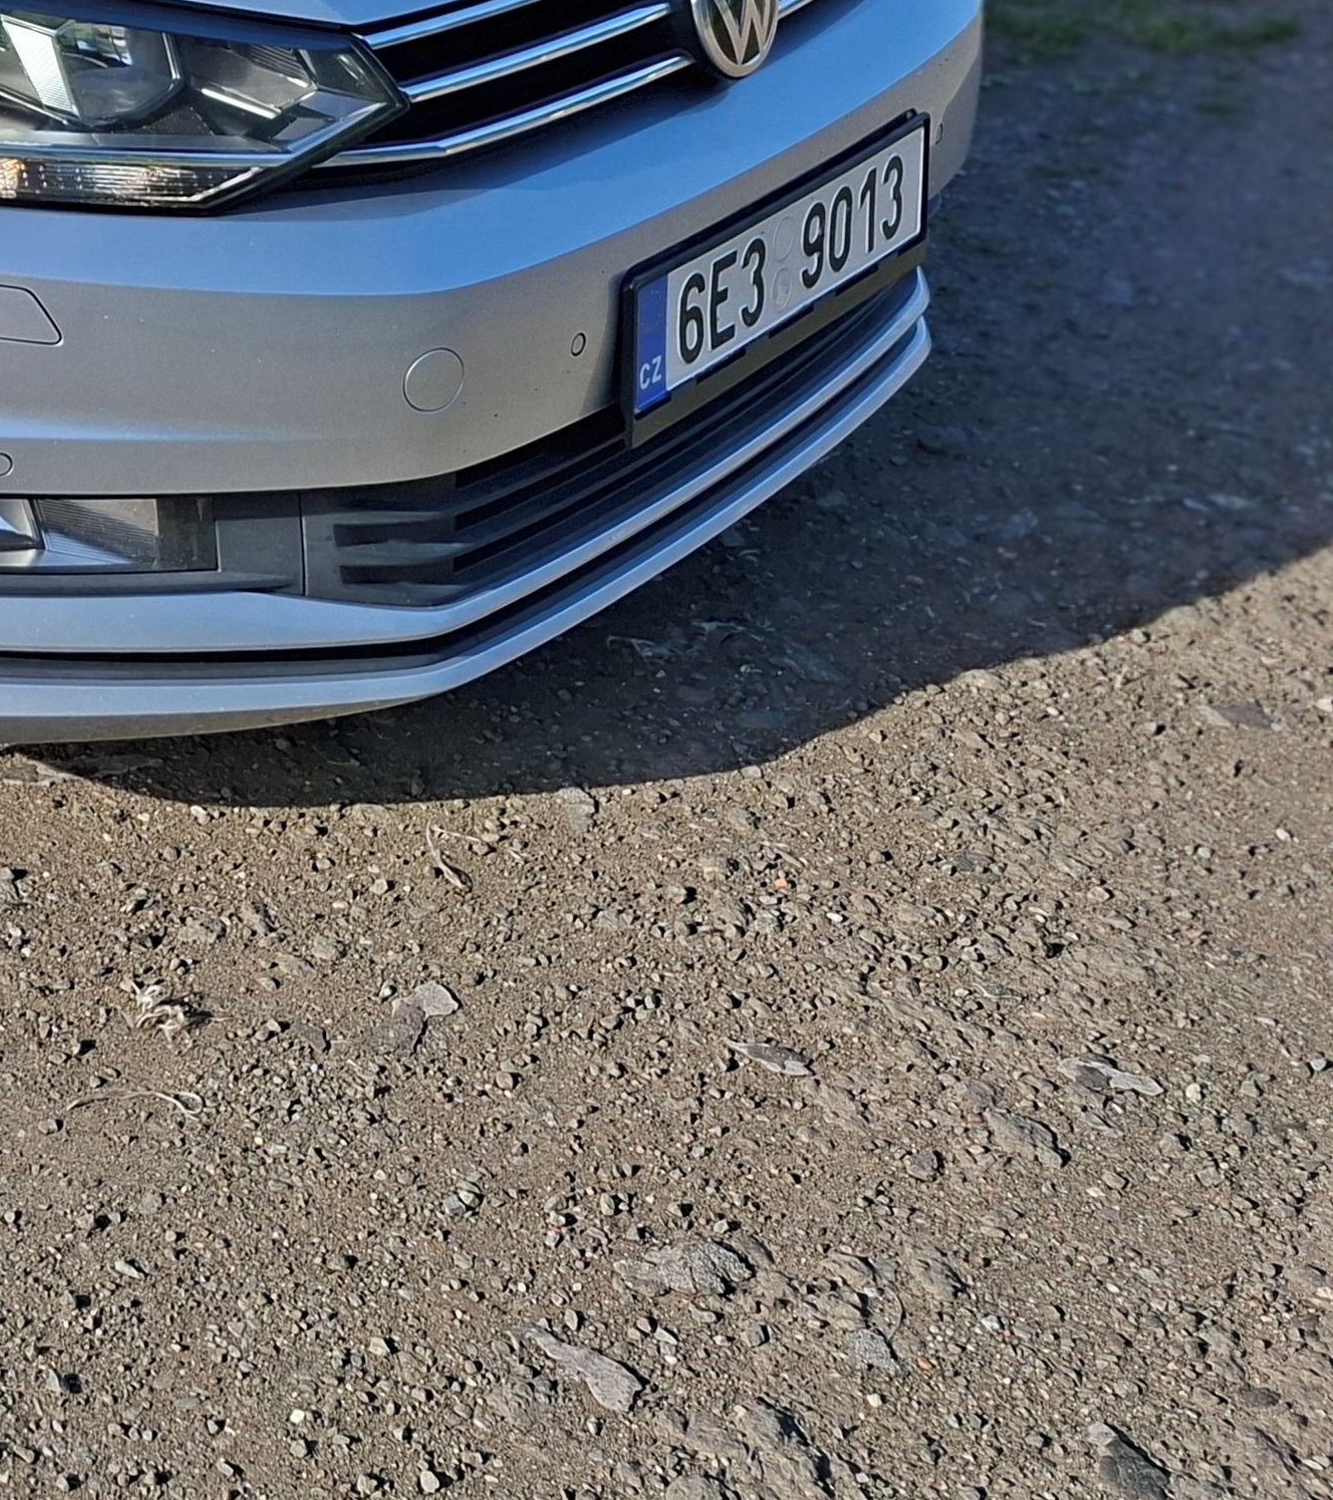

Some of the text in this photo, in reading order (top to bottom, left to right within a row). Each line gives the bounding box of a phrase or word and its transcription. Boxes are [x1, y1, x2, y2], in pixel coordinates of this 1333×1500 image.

[678, 155, 904, 365] 6E3 9013
[638, 354, 662, 390] CZ
